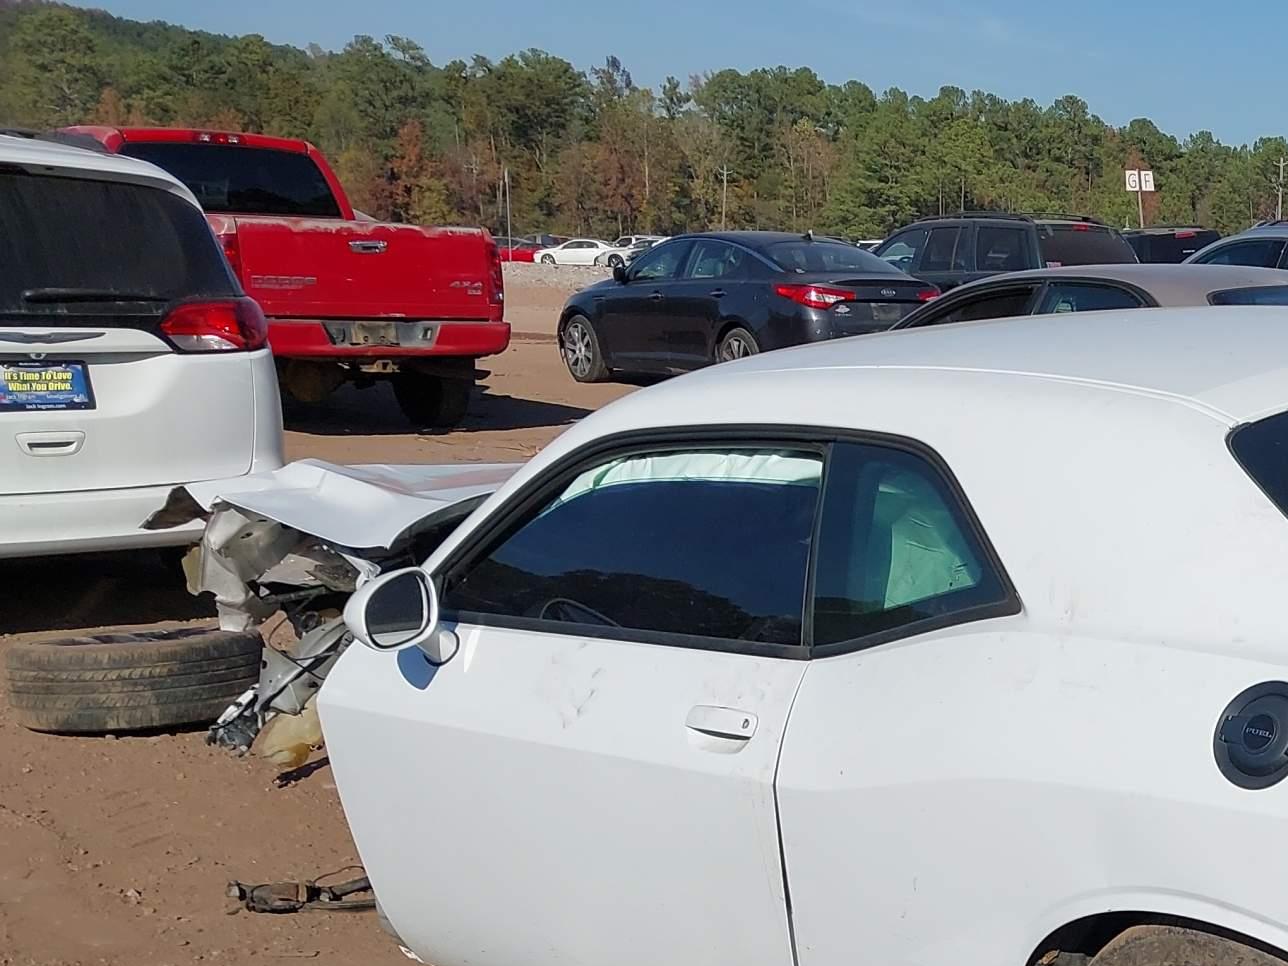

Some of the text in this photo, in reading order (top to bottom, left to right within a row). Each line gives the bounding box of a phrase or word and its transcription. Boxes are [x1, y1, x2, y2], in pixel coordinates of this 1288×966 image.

[1127, 173, 1151, 189] G F
[4, 371, 73, 380] It's Time To Love
[8, 382, 73, 391] What You Drive.
